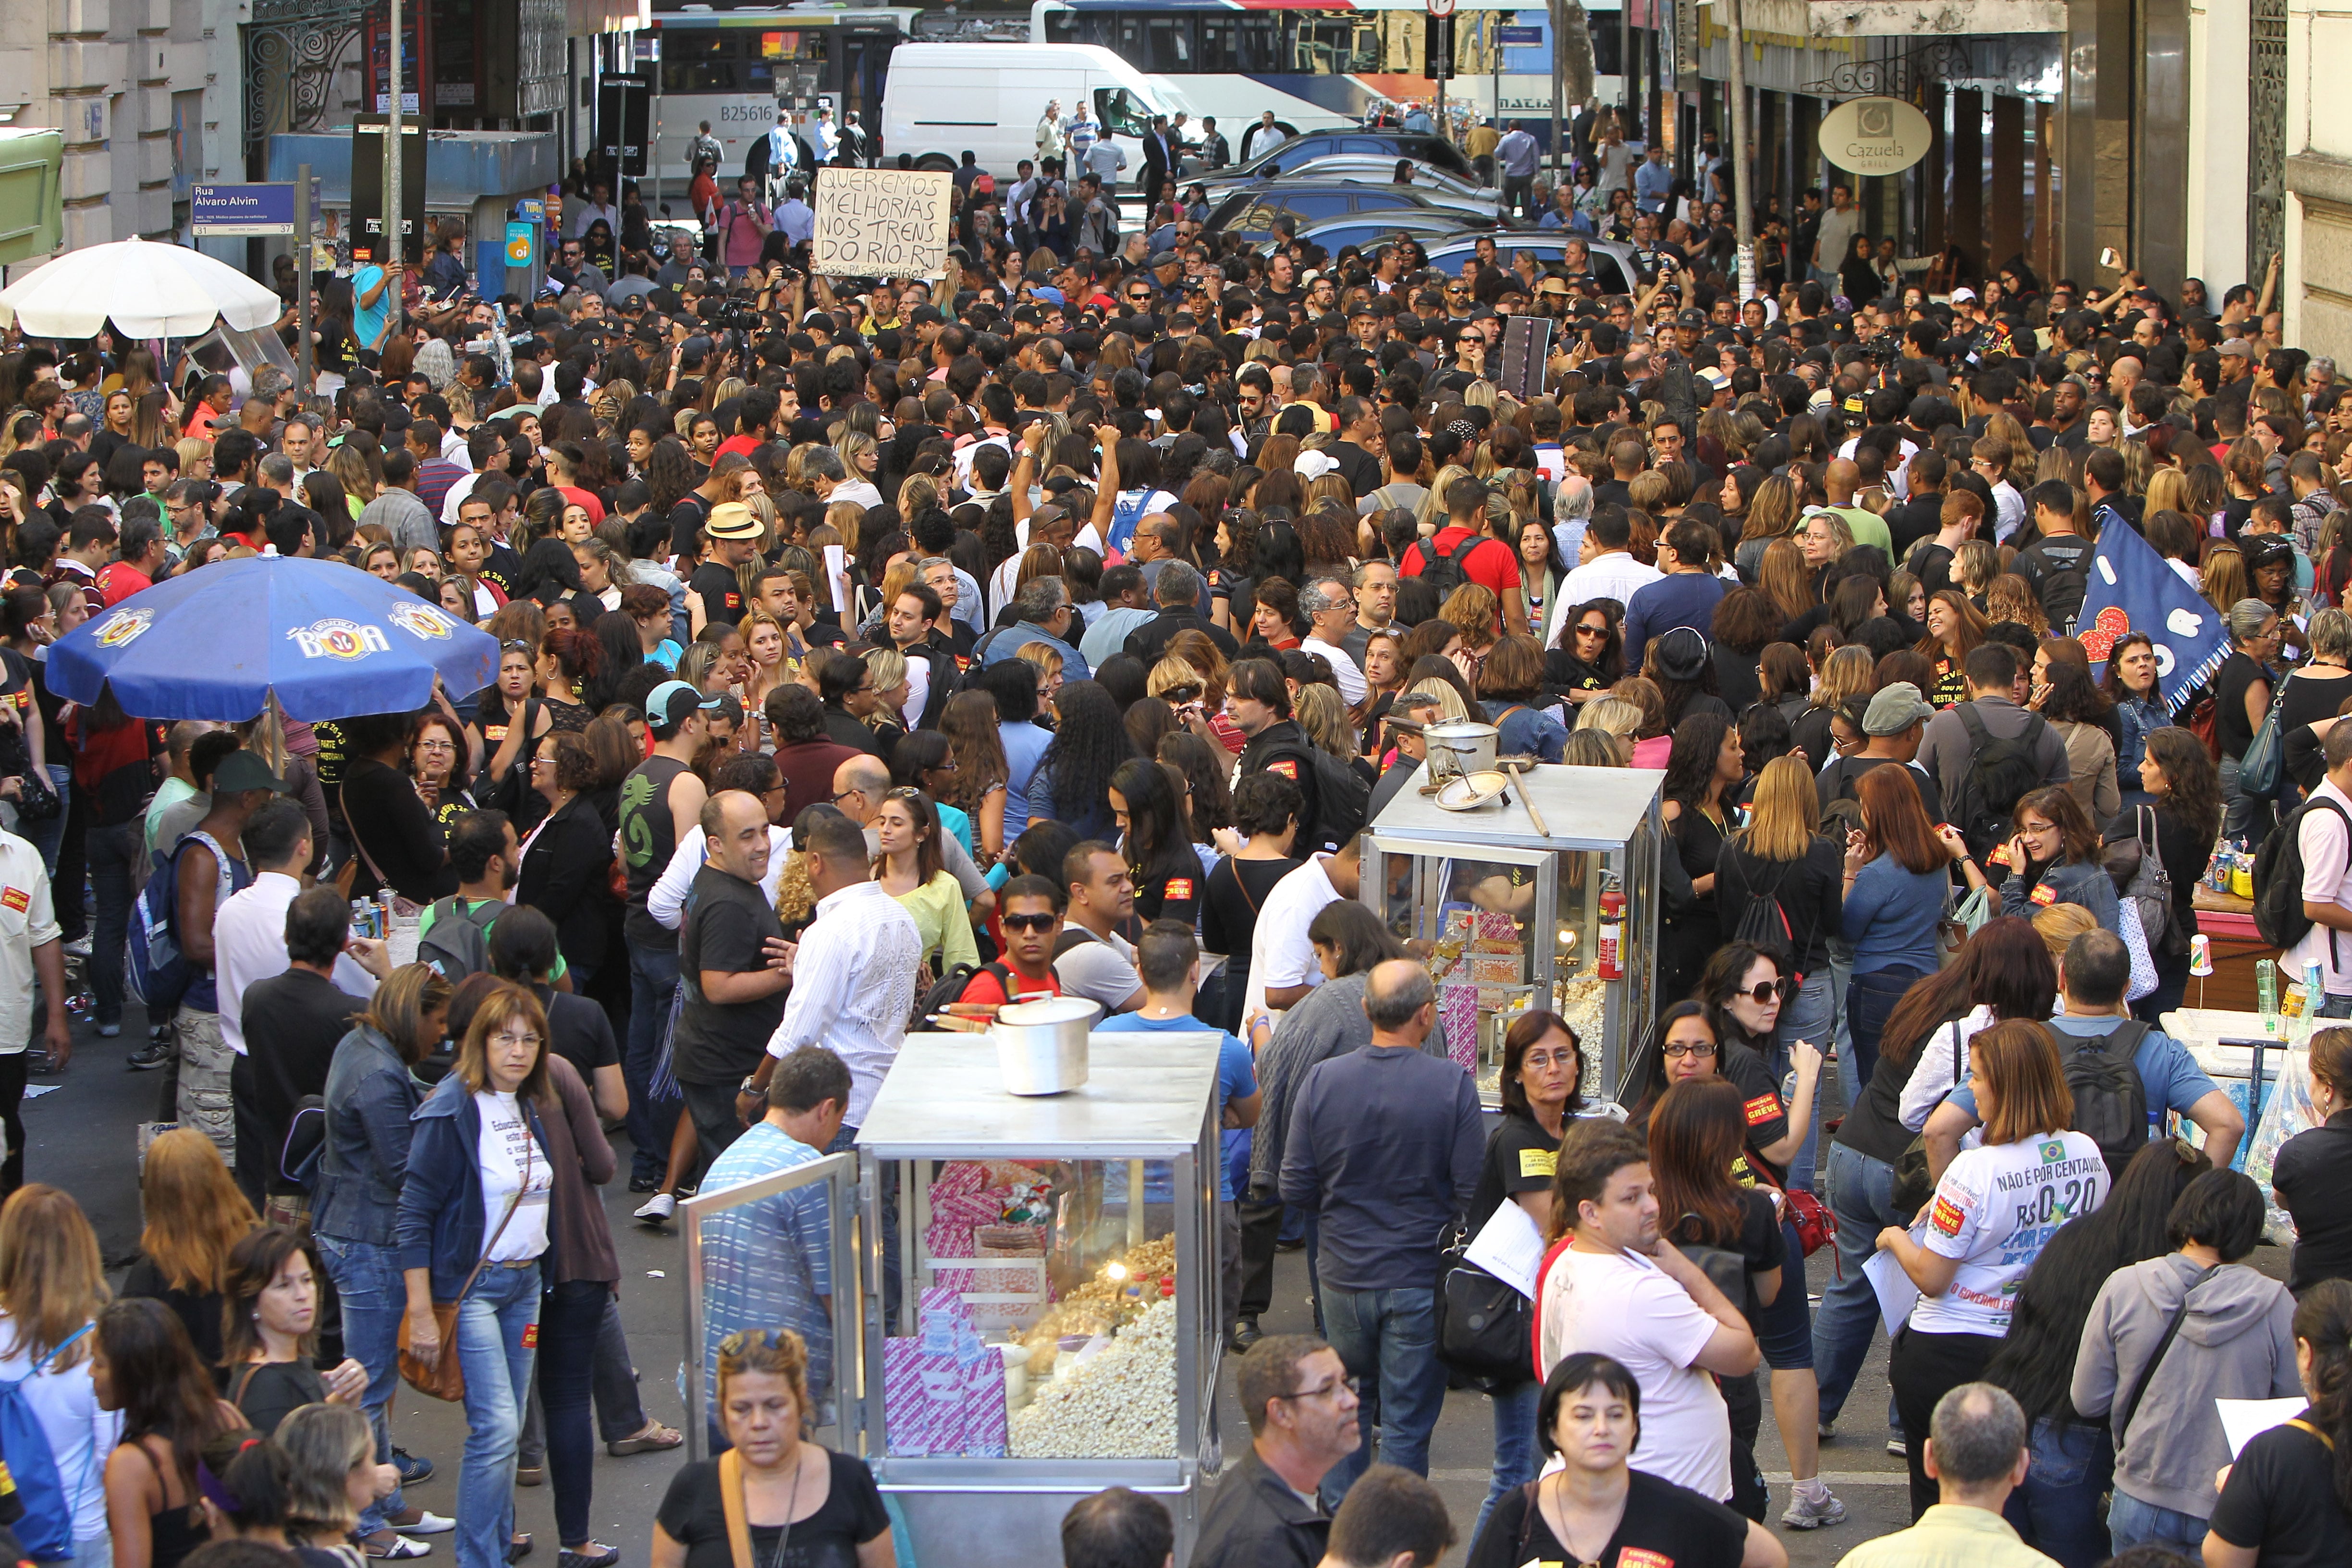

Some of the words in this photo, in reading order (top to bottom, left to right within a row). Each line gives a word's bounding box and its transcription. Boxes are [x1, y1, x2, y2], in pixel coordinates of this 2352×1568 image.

[721, 106, 771, 121] B25616
[1846, 140, 1903, 158] Cazuela
[195, 186, 213, 195] Rua
[195, 195, 227, 206] Álvaro
[229, 196, 258, 205] Alvim
[820, 192, 937, 220] MELHORIAS
[820, 216, 861, 239] NOS
[867, 220, 939, 243] TRENS
[516, 245, 527, 257] oi
[821, 240, 859, 261] DO
[849, 265, 927, 278] PASSAGEIROS
[491, 572, 509, 591] 2013
[1933, 694, 1952, 703] DESTA
[320, 740, 336, 749] PARTE
[1746, 1096, 1773, 1109] EDUCAÇÃO
[1748, 1103, 1778, 1119] GREVE
[1997, 1171, 2023, 1192] NÃO
[2026, 1167, 2032, 1185] É
[2033, 1167, 2054, 1184] POR
[2055, 1156, 2103, 1178] CENTAVOS.
[1934, 1205, 1959, 1228] GREVE
[2010, 1230, 2036, 1249] POR
[2038, 1227, 2053, 1245] ED
[1950, 1283, 1959, 1294] O
[1958, 1286, 2000, 1309] GOVERNO
[2002, 1299, 2014, 1311] ES
